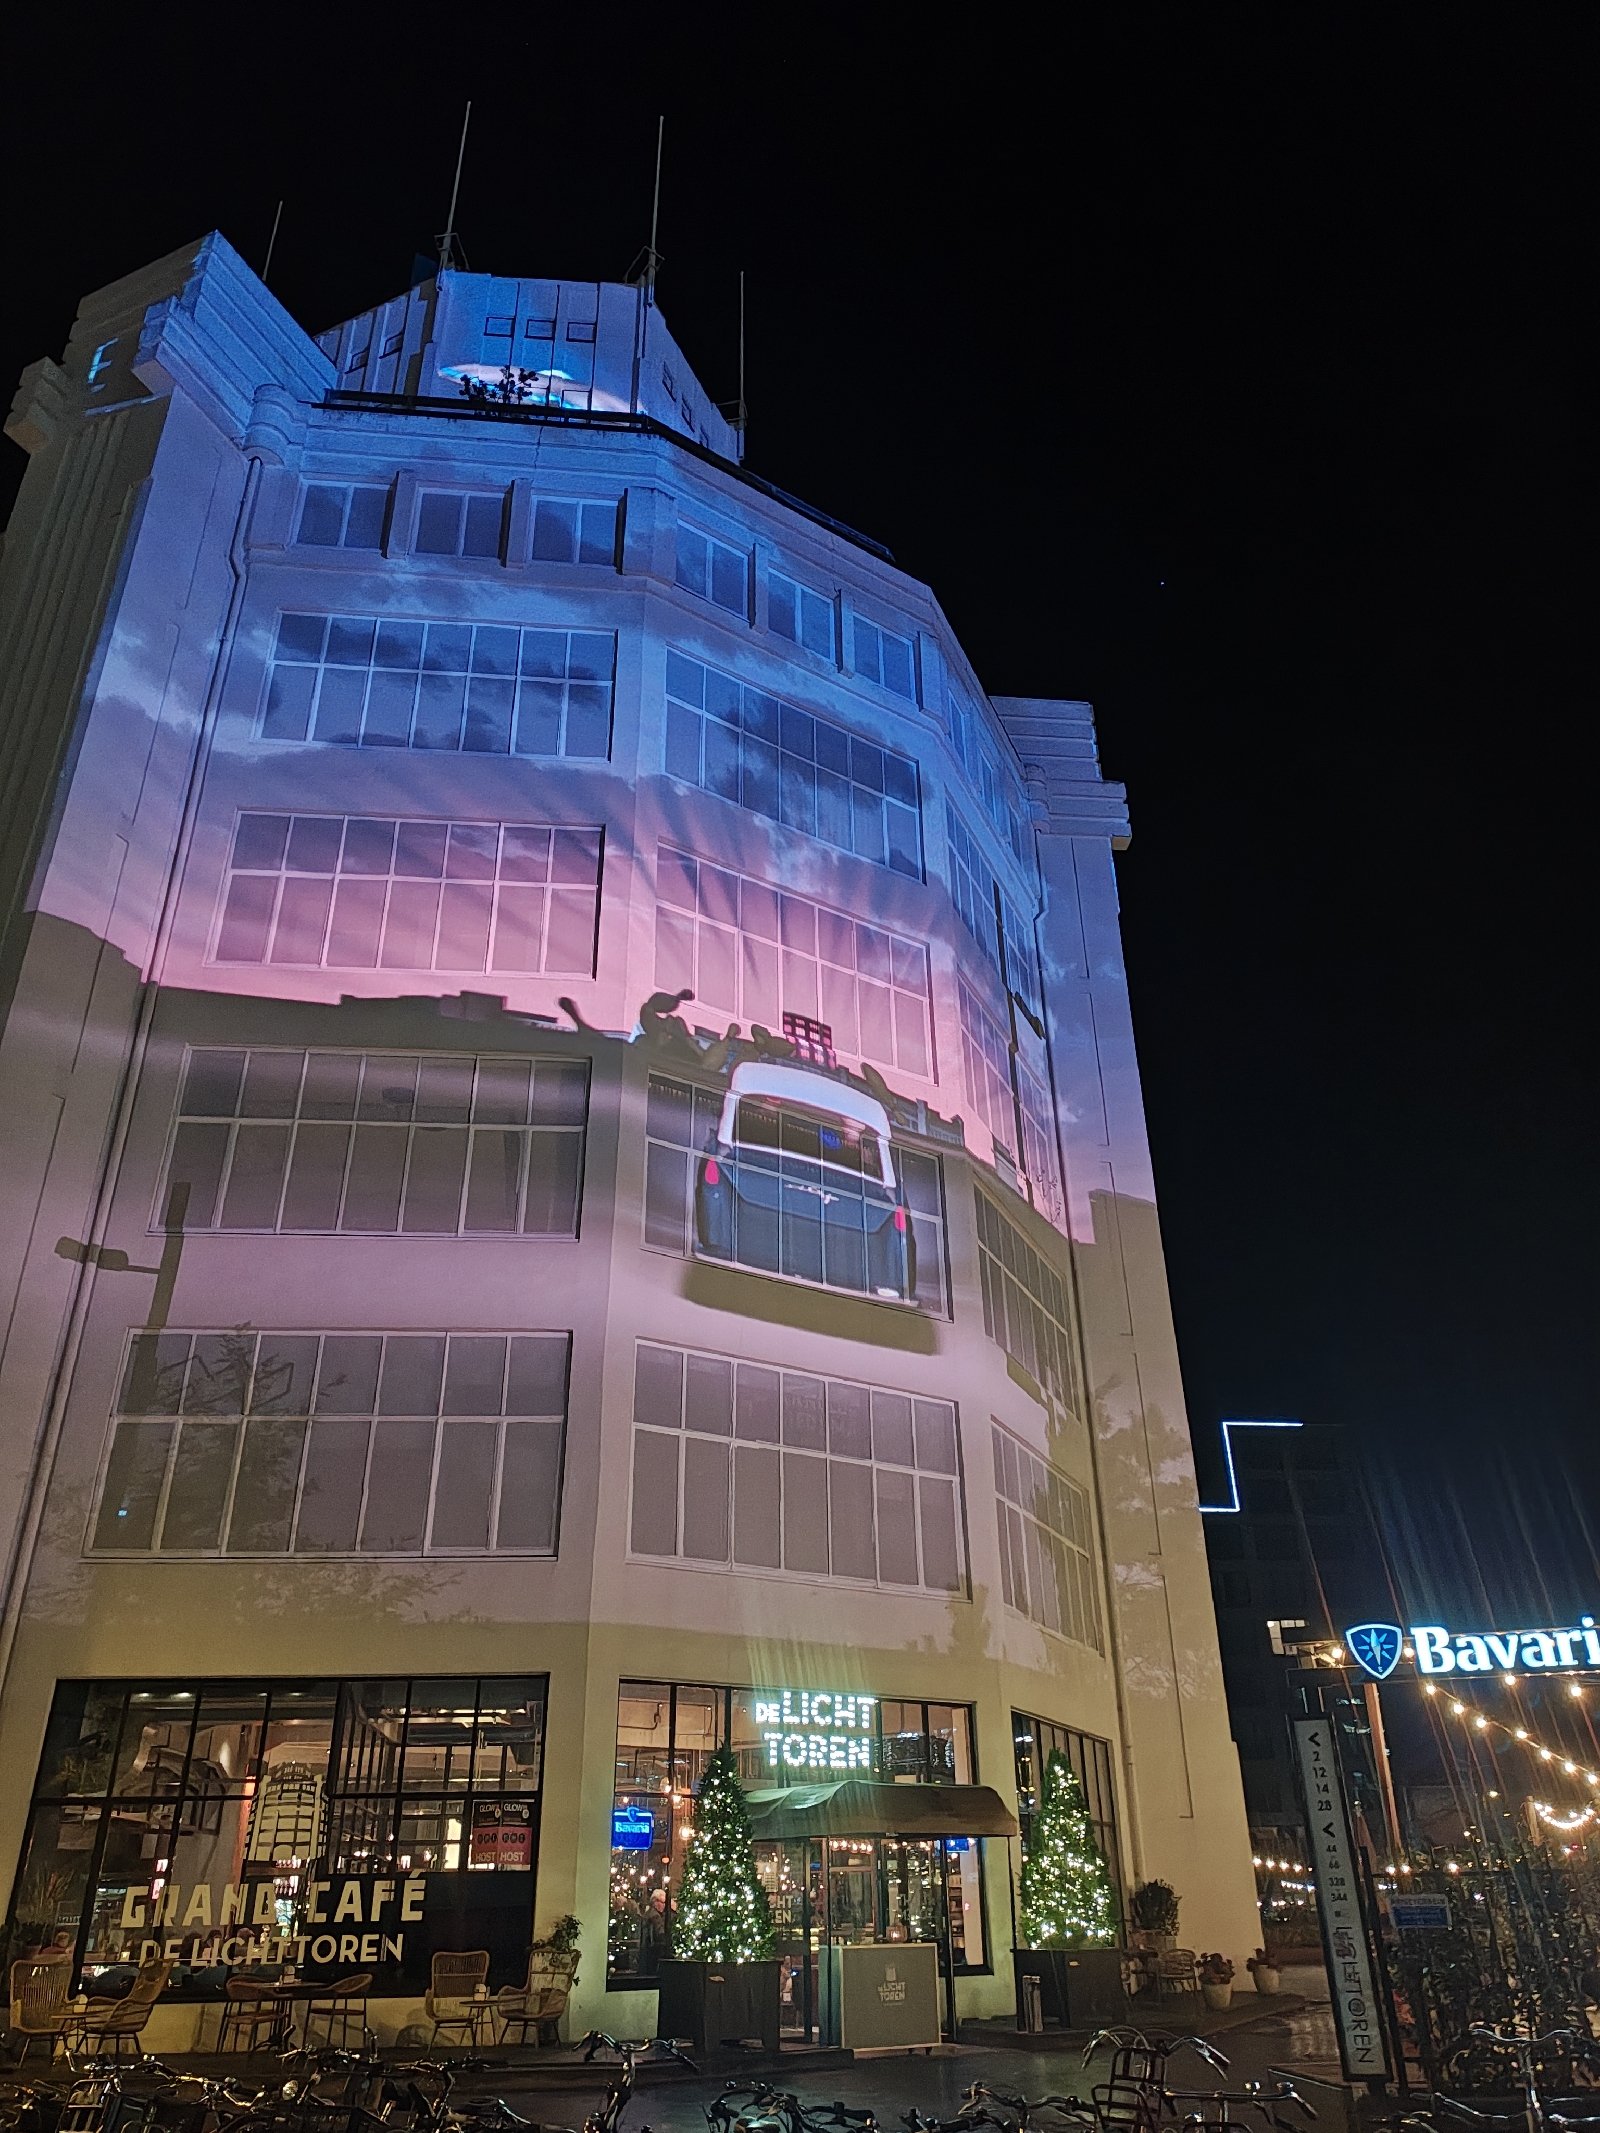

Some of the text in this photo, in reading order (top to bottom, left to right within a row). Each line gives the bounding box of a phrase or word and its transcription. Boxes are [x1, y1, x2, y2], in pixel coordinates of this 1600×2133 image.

[755, 1691, 876, 1728] DE LICHT
[763, 1732, 870, 1769] TOREN
[1312, 1751, 1321, 1762] 2
[1312, 1766, 1327, 1779] 12
[1315, 1783, 1330, 1795] 14
[503, 1803, 523, 1812] GLOW
[475, 1852, 496, 1862] HOST
[500, 1851, 524, 1862] HOST
[120, 1870, 427, 1929] GRAND CAFÉ
